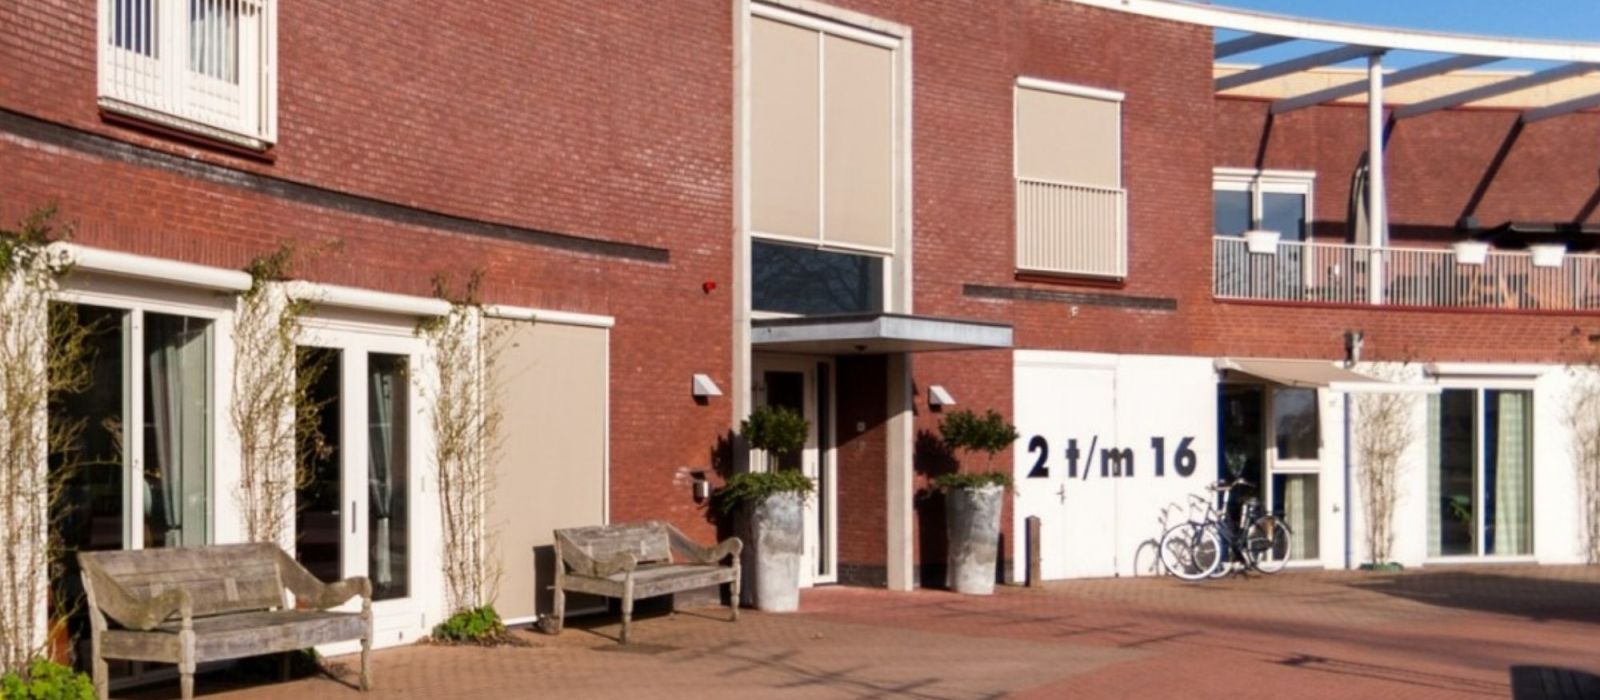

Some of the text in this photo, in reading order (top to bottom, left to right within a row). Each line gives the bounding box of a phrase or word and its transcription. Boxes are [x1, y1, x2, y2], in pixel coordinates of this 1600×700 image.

[1028, 435, 1197, 481] 2 t/m 16
